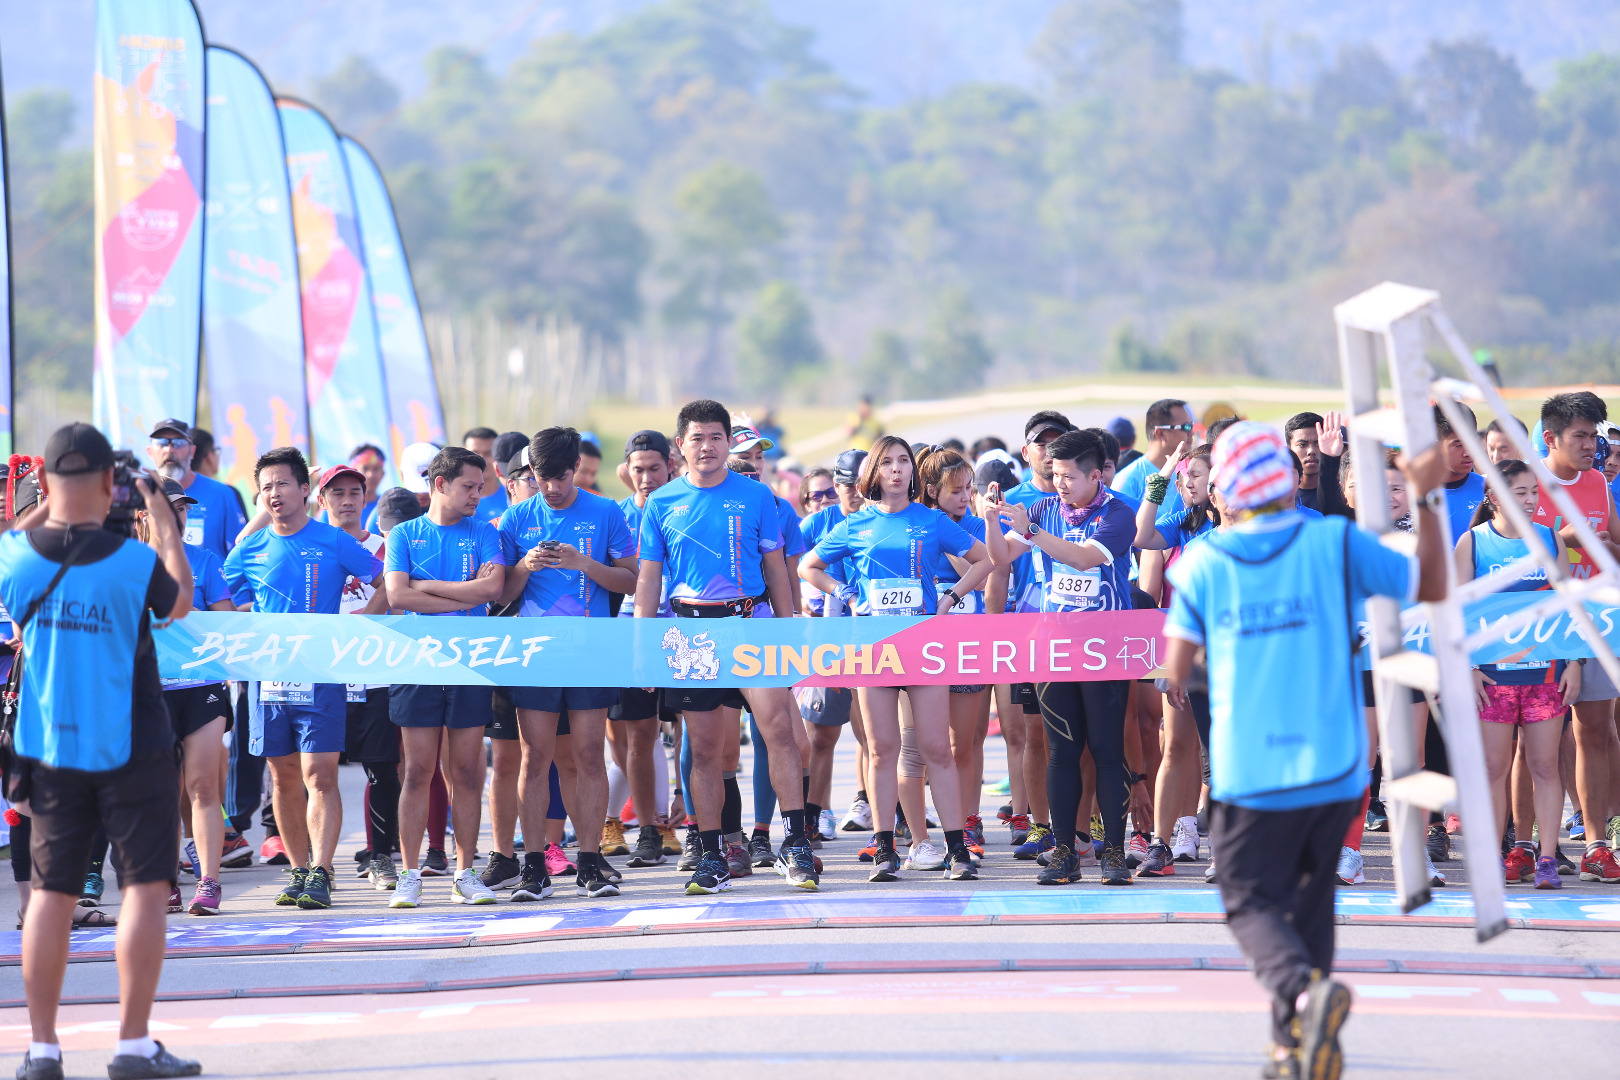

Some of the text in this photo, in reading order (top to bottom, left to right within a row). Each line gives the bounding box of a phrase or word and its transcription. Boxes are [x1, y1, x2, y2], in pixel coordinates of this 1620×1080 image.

[881, 590, 912, 605] 6216
[1058, 577, 1092, 593] 6387
[181, 631, 553, 670] BEAT YOURSELF
[730, 643, 906, 677] SINGHA
[921, 638, 1107, 674] SERIES
